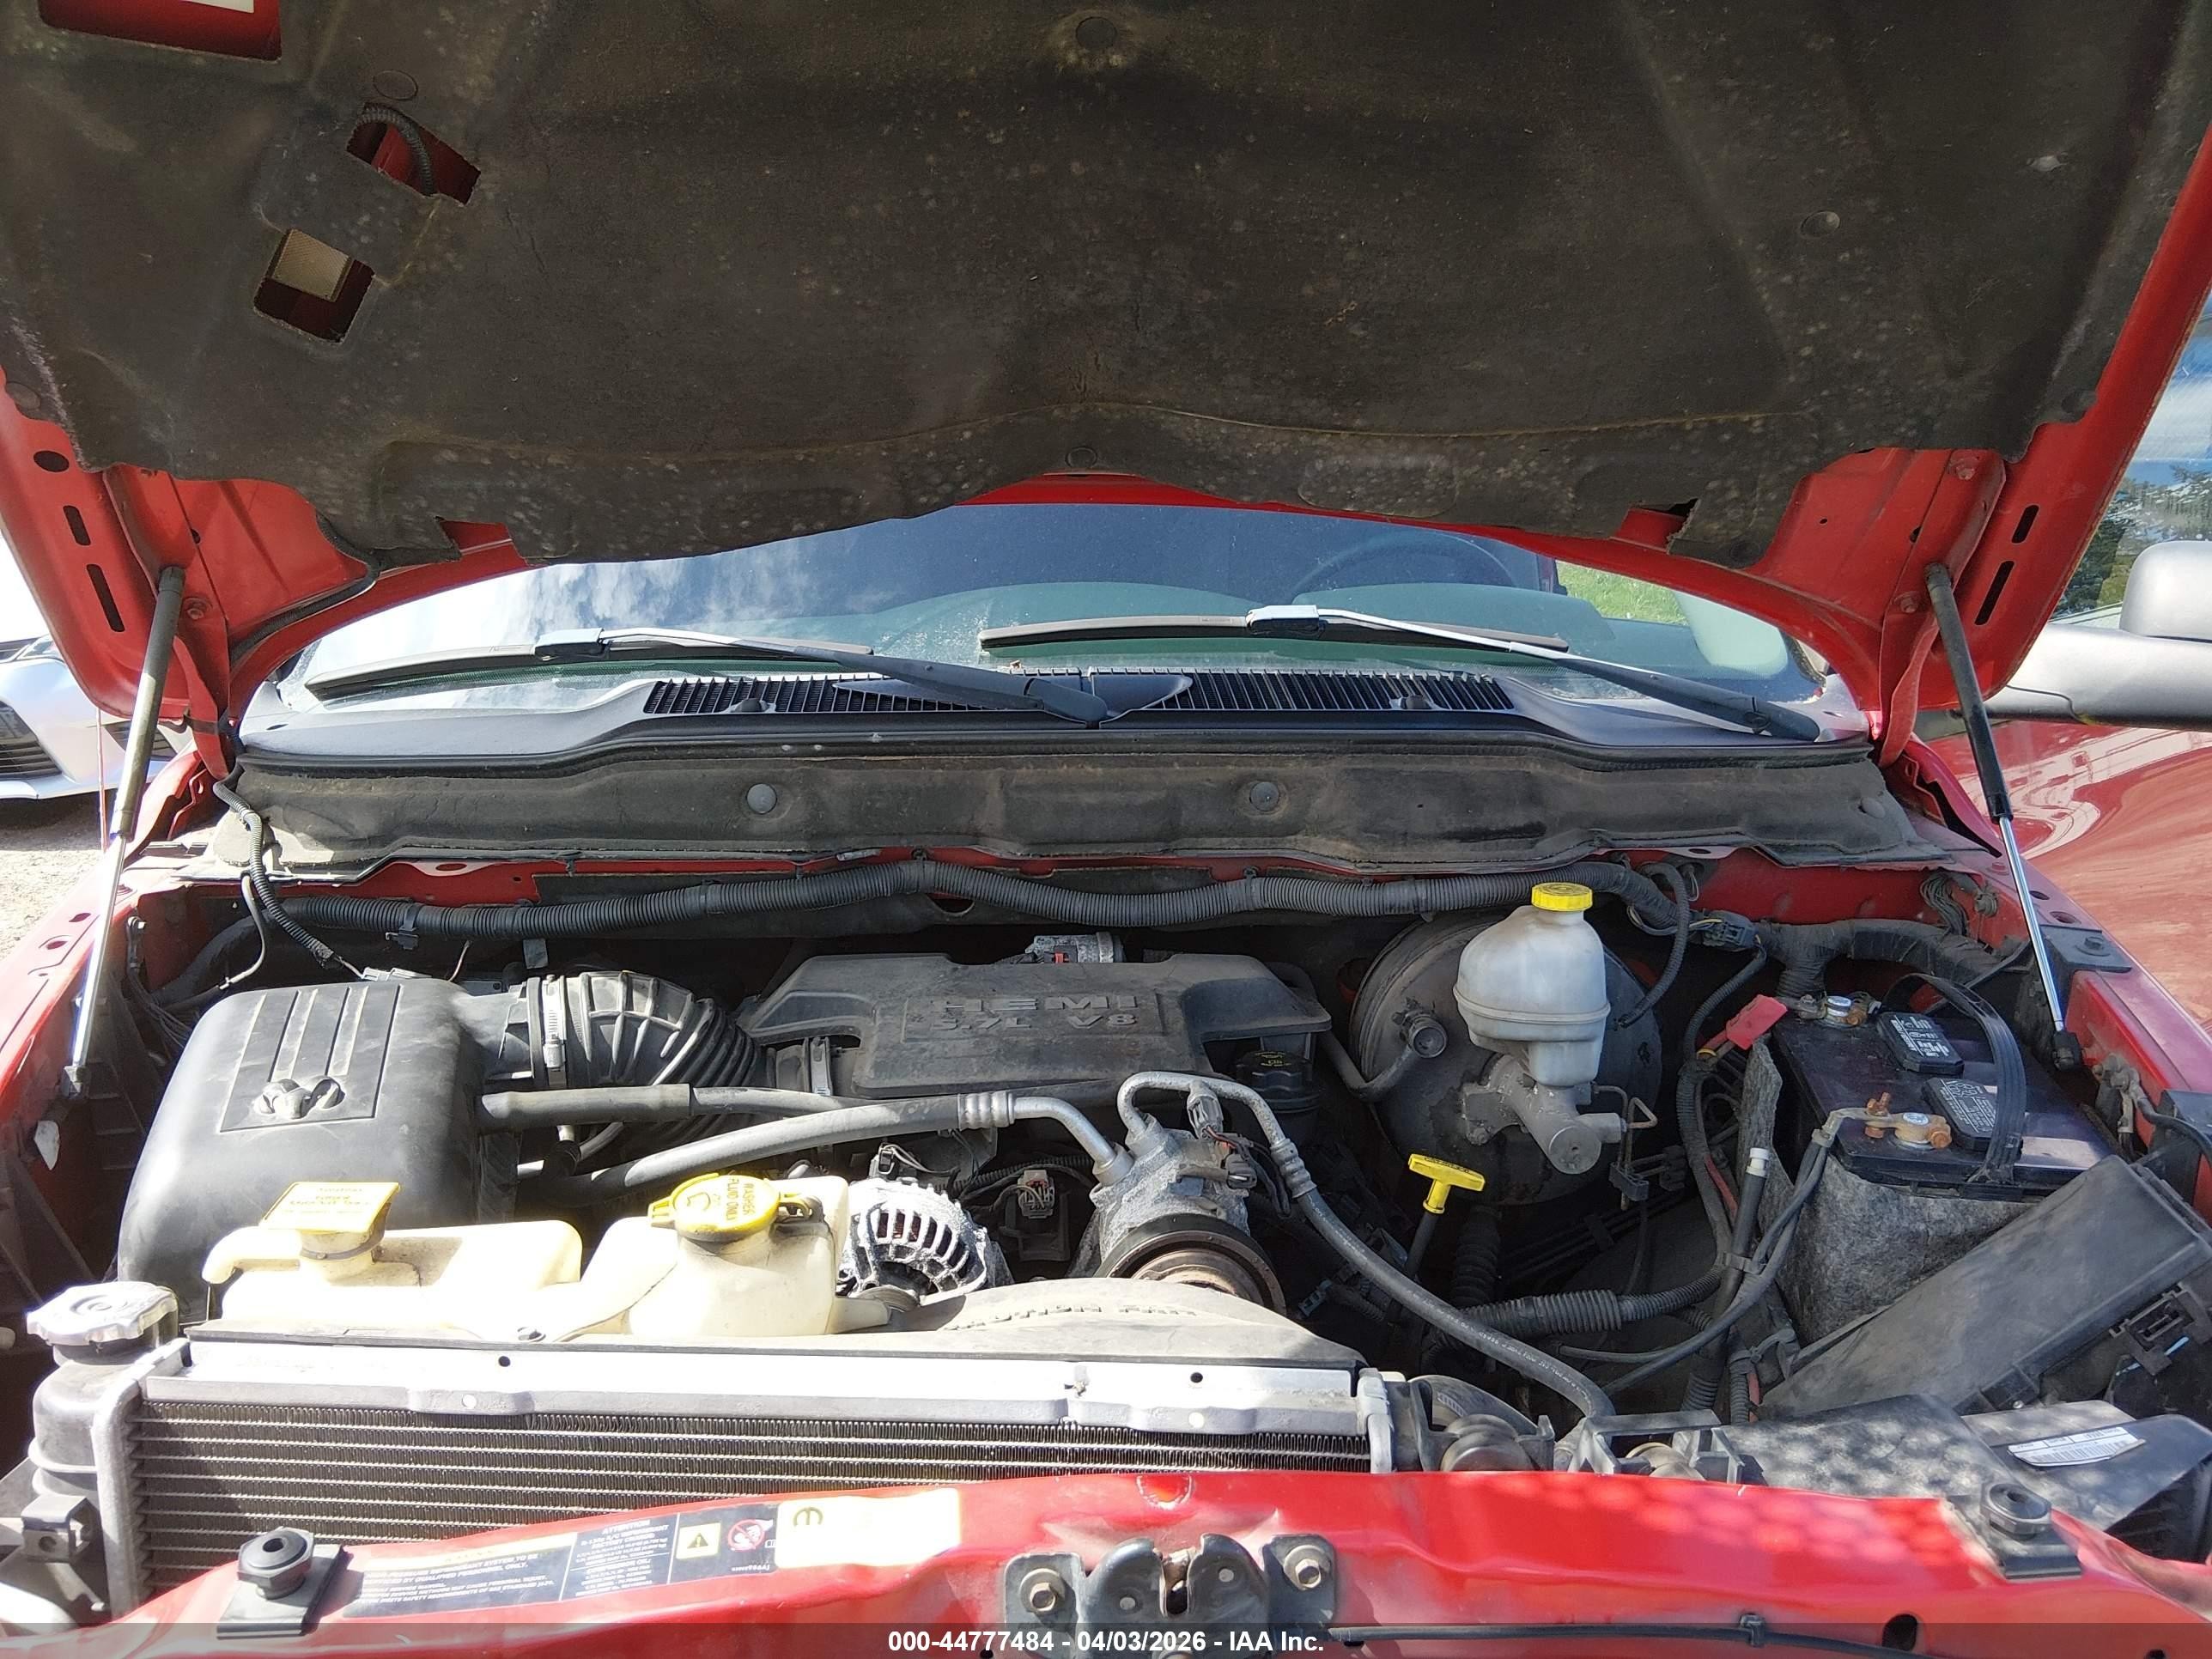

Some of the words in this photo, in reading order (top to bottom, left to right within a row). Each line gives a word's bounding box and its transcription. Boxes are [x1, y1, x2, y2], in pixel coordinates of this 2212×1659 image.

[931, 1017, 1031, 1030] 5.7L
[1067, 1013, 1138, 1030] V8
[726, 1177, 739, 1202] FLUID
[742, 1182, 757, 1216] WASHER
